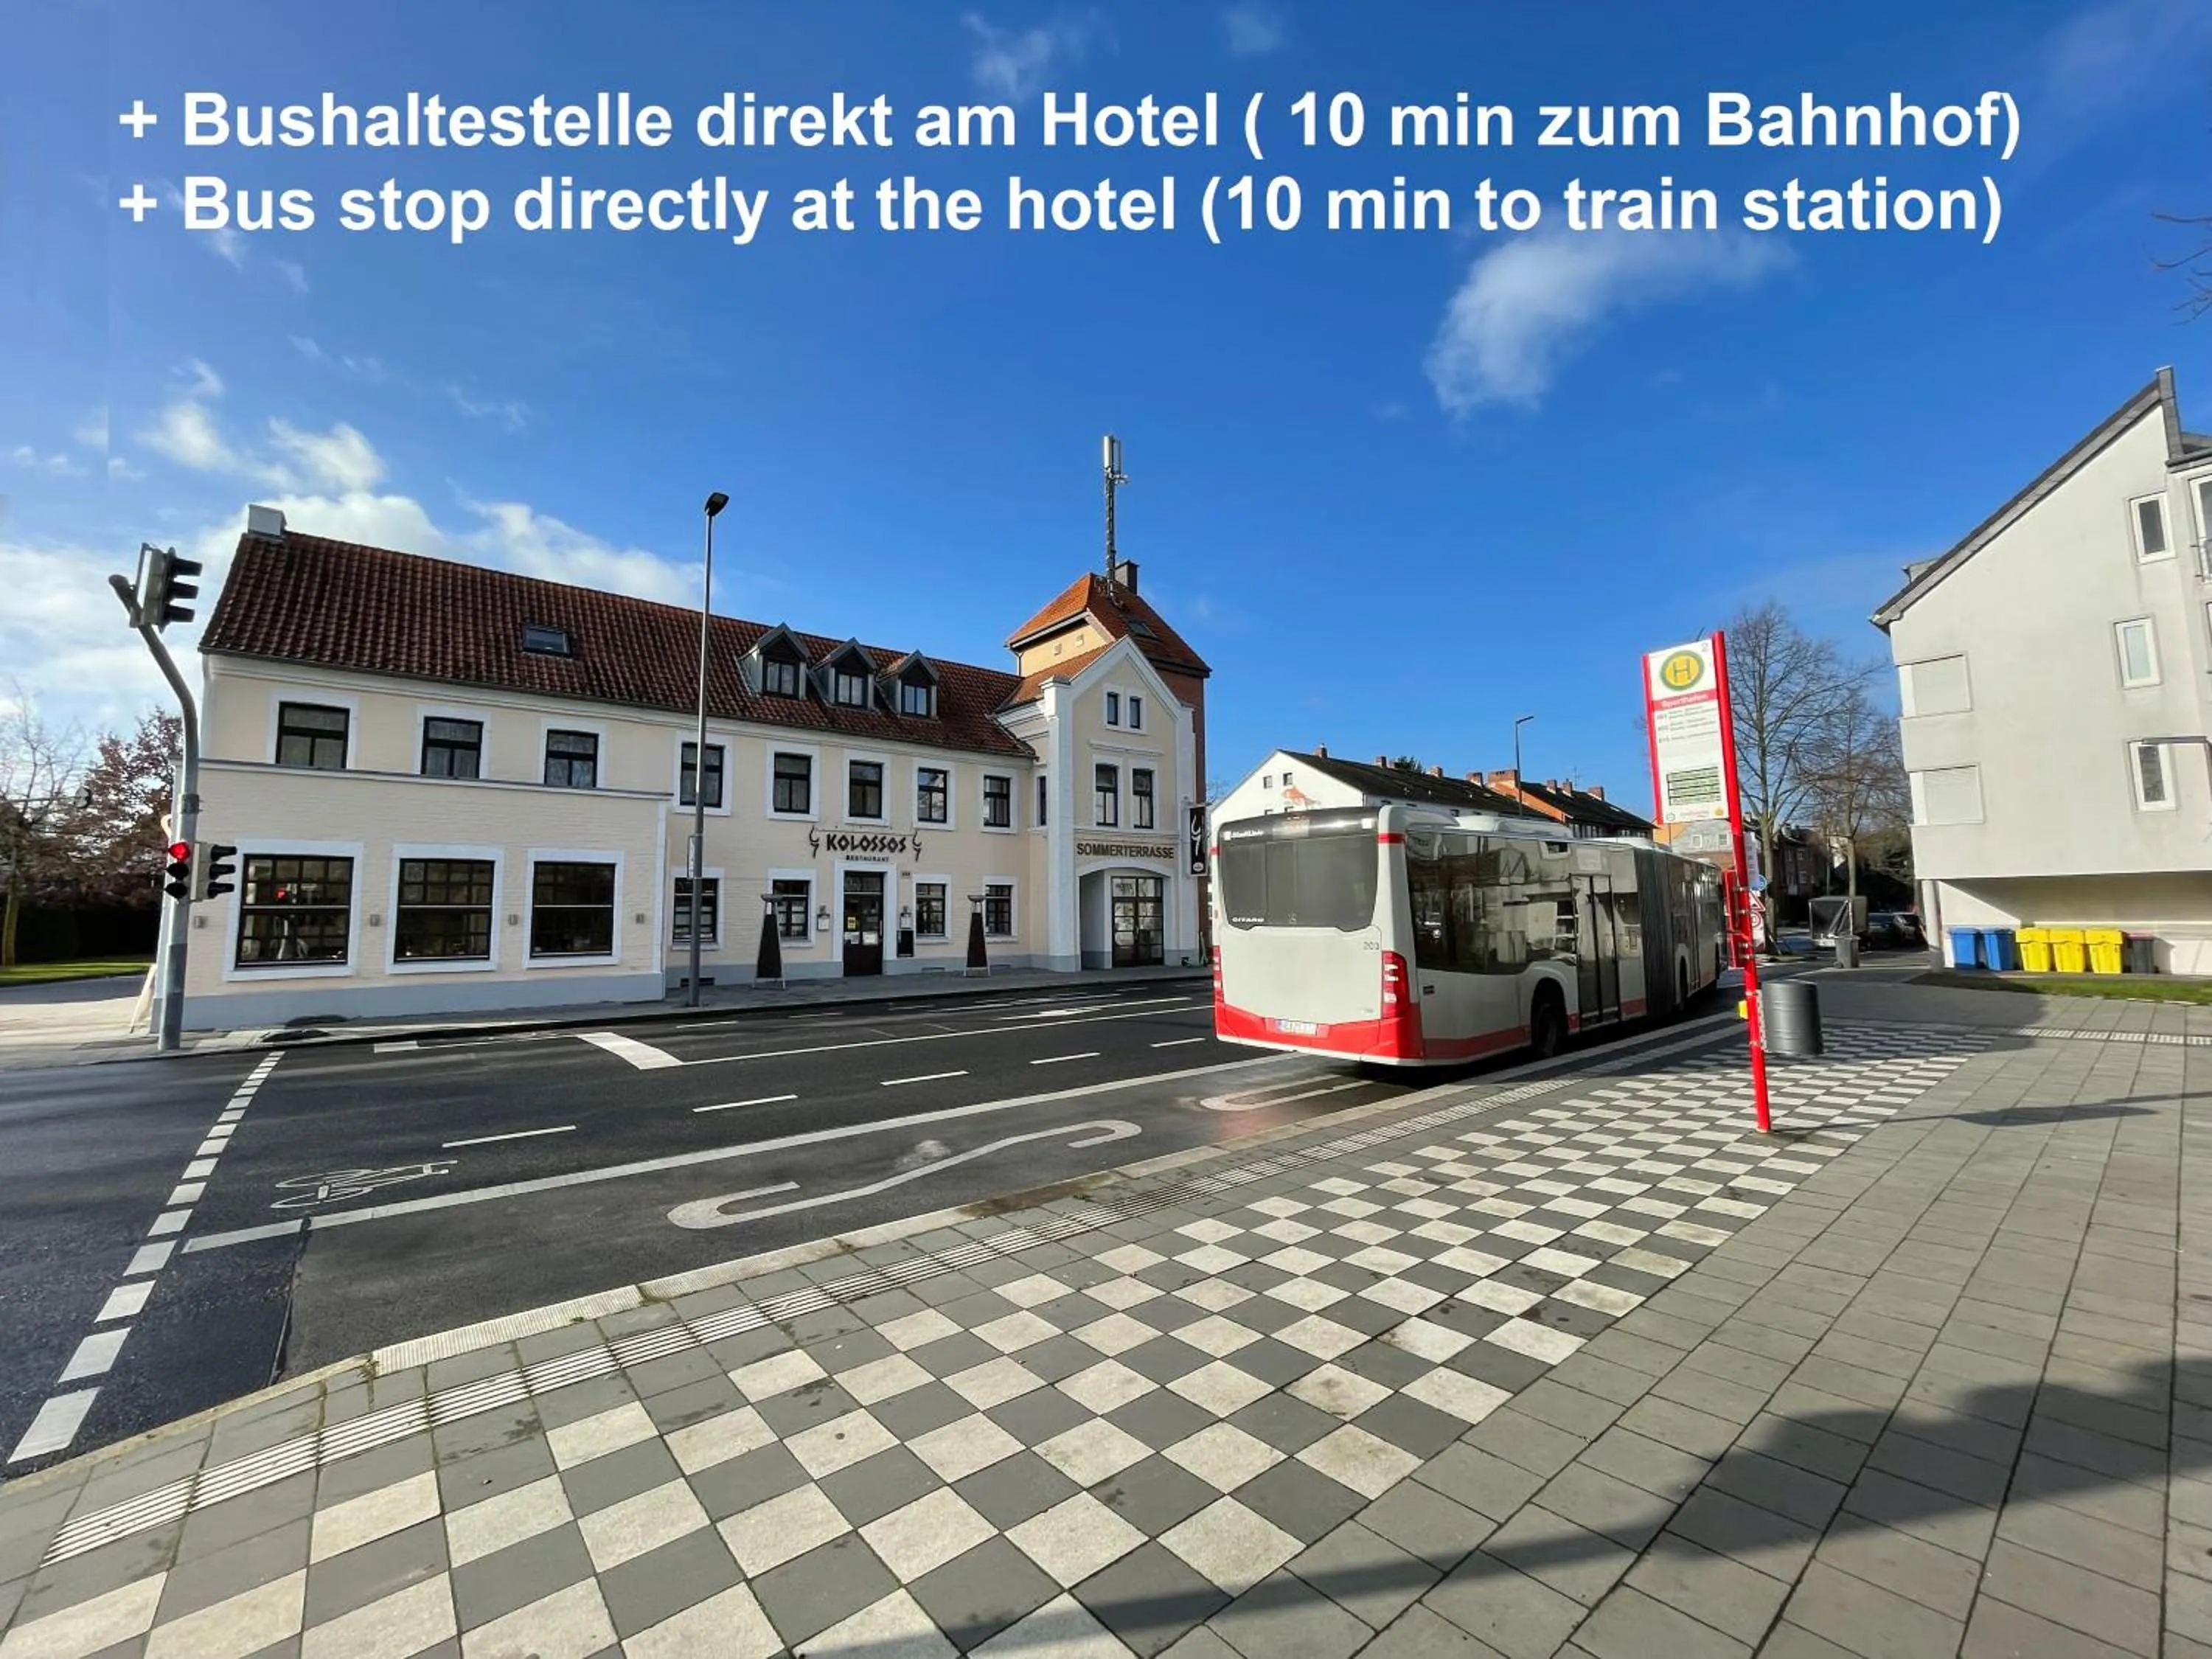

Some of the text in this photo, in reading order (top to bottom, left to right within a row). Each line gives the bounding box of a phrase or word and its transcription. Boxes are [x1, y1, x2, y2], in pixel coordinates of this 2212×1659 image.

[1672, 657, 1691, 684] H
[827, 833, 907, 853] KOLOSSOS
[1077, 843, 1175, 859] SOMMERTERRASSE
